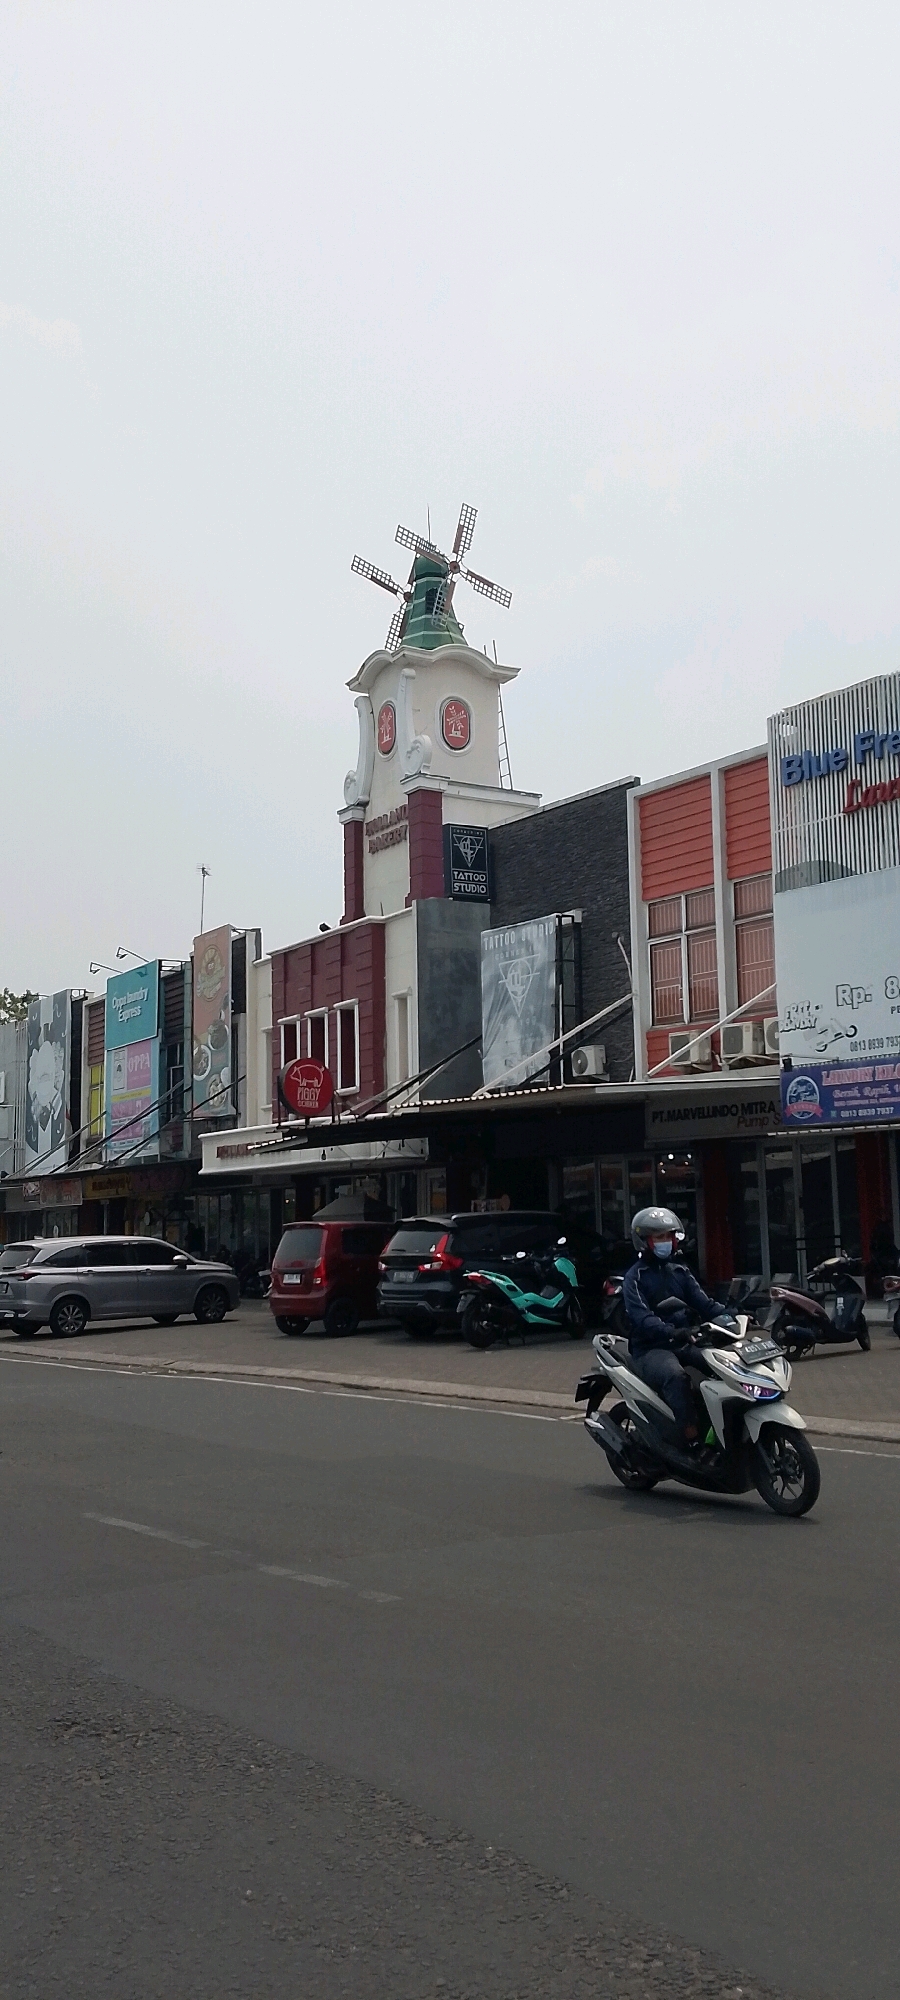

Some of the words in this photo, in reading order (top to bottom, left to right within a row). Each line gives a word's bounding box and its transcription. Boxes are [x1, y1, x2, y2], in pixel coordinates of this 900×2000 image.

[781, 748, 848, 787] Blue
[368, 825, 408, 855] BAKERY
[453, 871, 486, 882] TATTOO
[453, 882, 487, 893] STUDIO
[483, 931, 516, 951] TATTOO
[522, 921, 554, 942] STUDIO
[836, 984, 873, 1010] Rp.
[118, 1006, 141, 1023] Express
[128, 1053, 150, 1073] OPPA
[821, 1066, 874, 1086] LAUNDRY
[297, 1086, 321, 1101] PIGGY
[740, 1100, 776, 1115] MITRA
[737, 1115, 770, 1129] Pump
